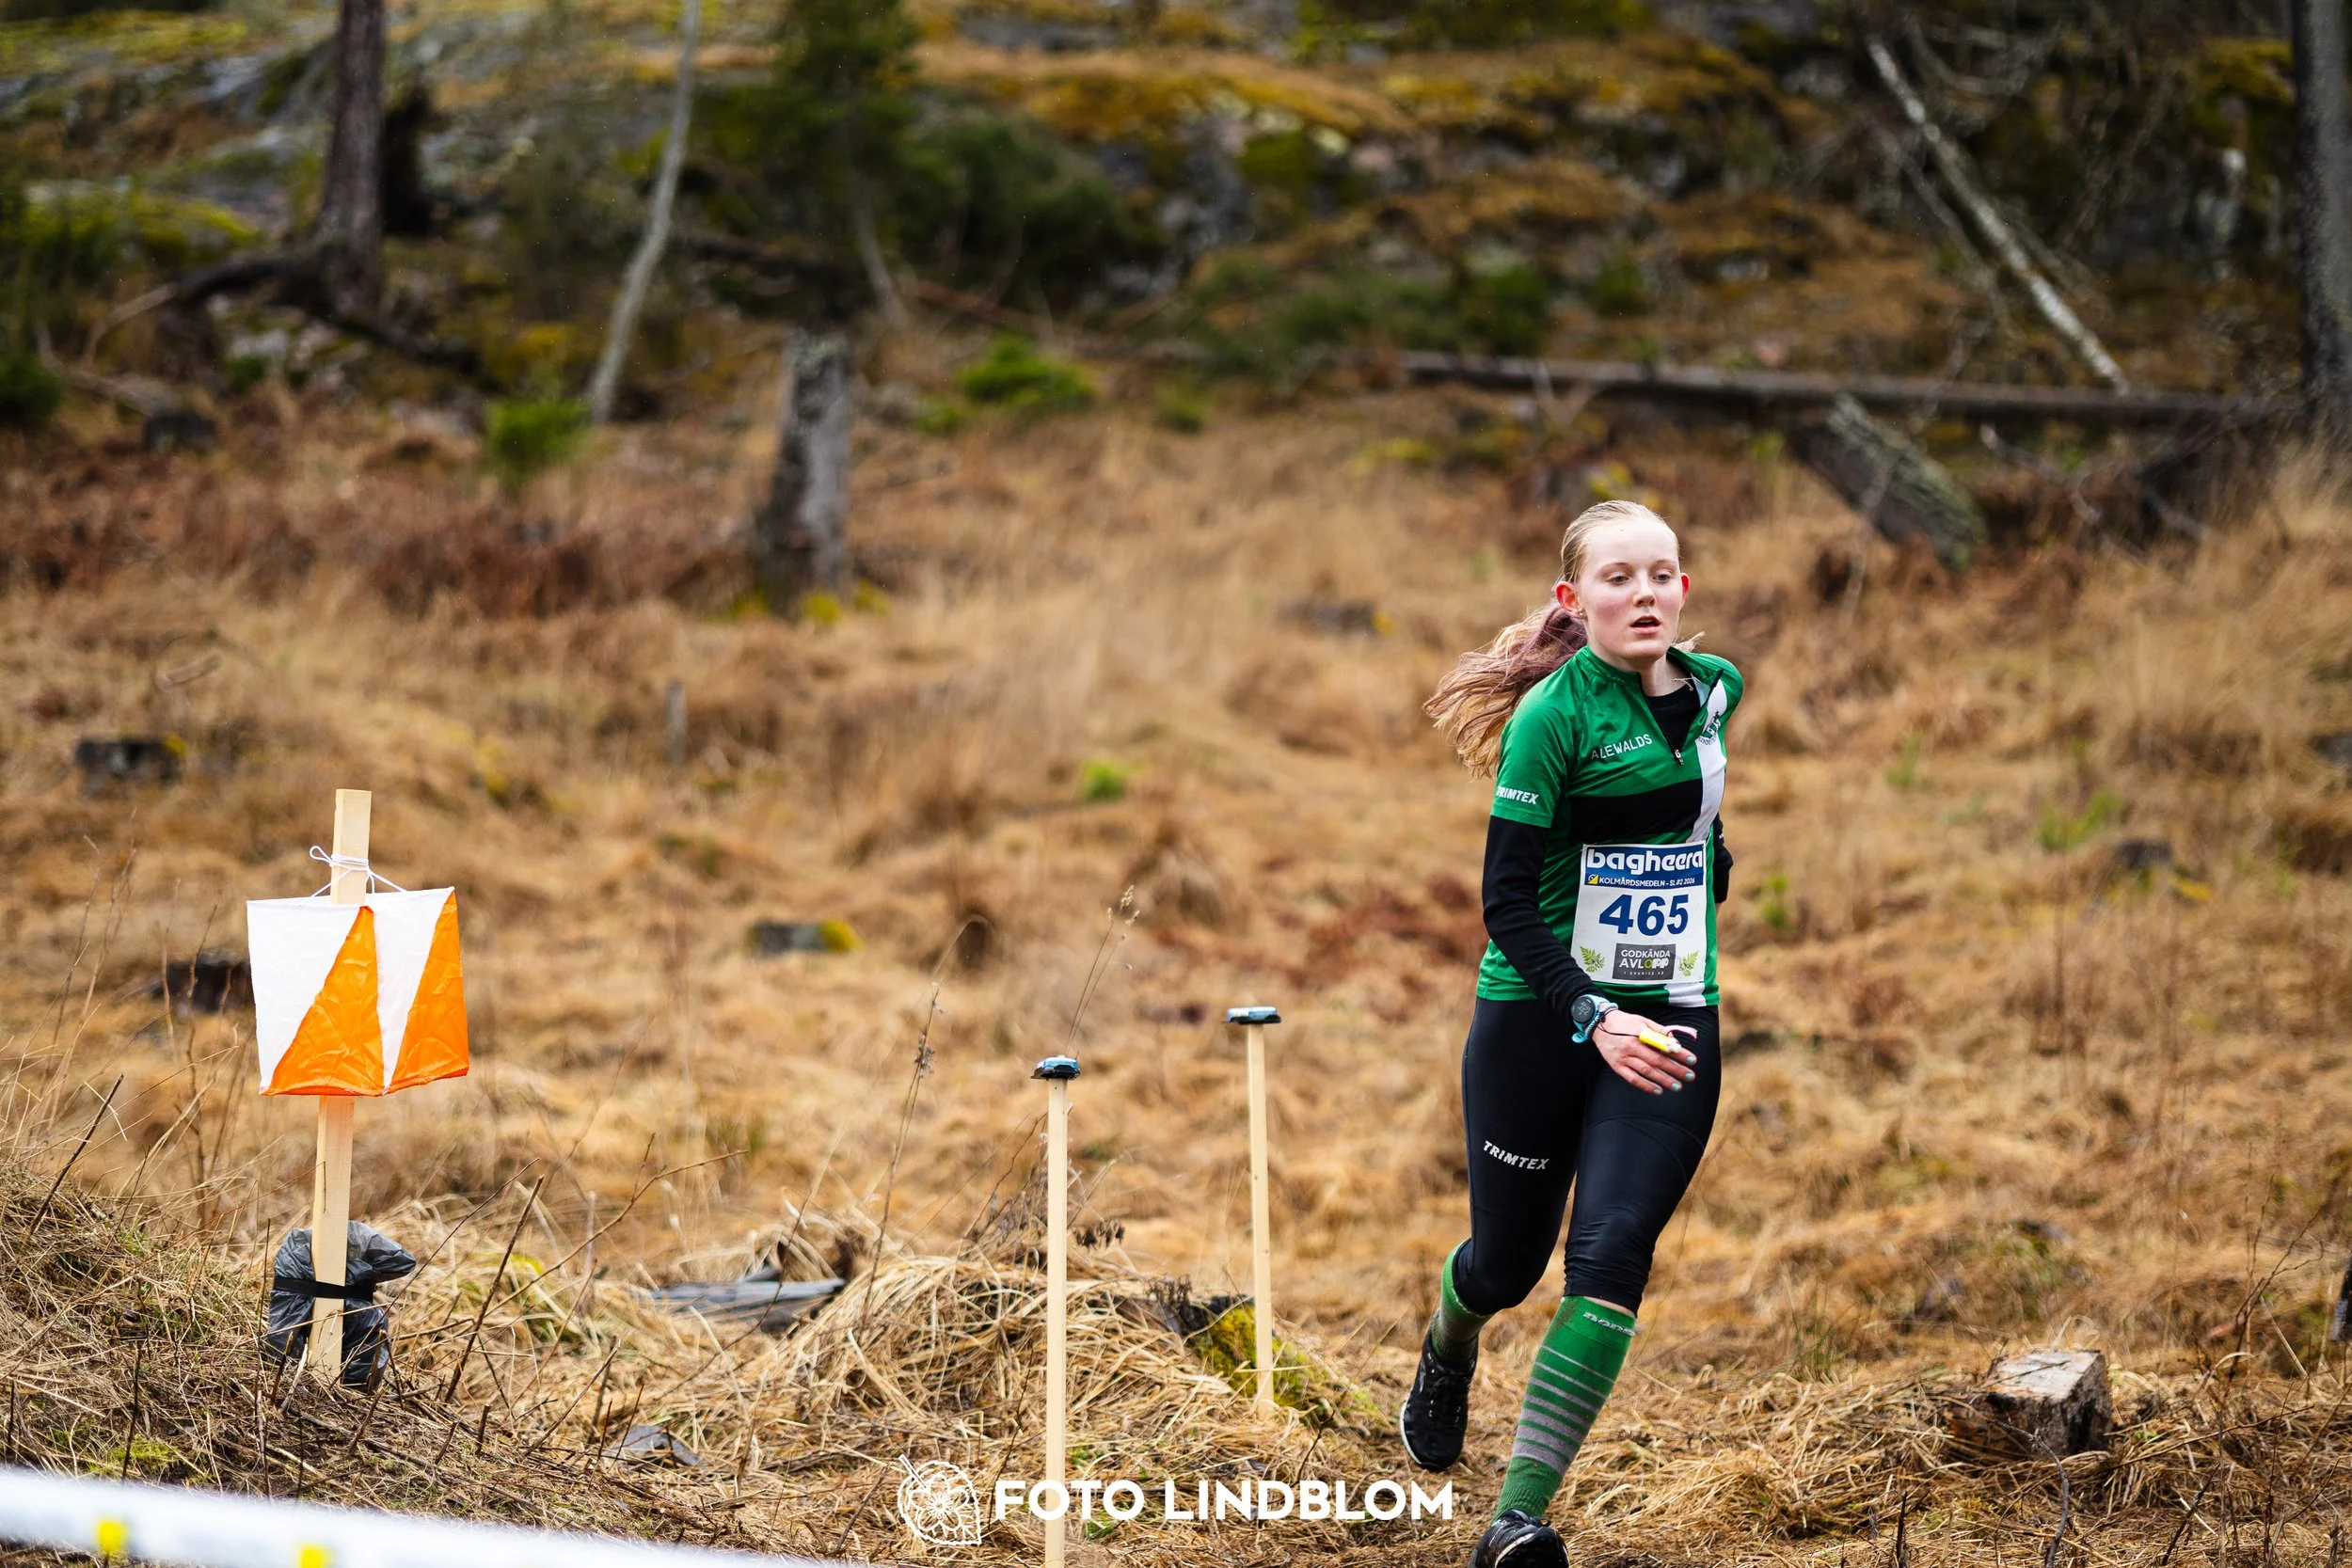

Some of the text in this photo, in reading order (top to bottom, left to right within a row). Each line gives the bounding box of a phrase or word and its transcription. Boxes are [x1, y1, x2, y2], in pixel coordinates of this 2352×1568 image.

[1591, 734, 1652, 759] ALEWALDS
[1587, 848, 1703, 875] bagheera
[1599, 877, 1665, 887] KOLMÅRDSMEDELN
[1598, 894, 1689, 936] 465
[1621, 949, 1671, 958] GODKÄNDA
[1483, 1141, 1549, 1170] TRIMTEX
